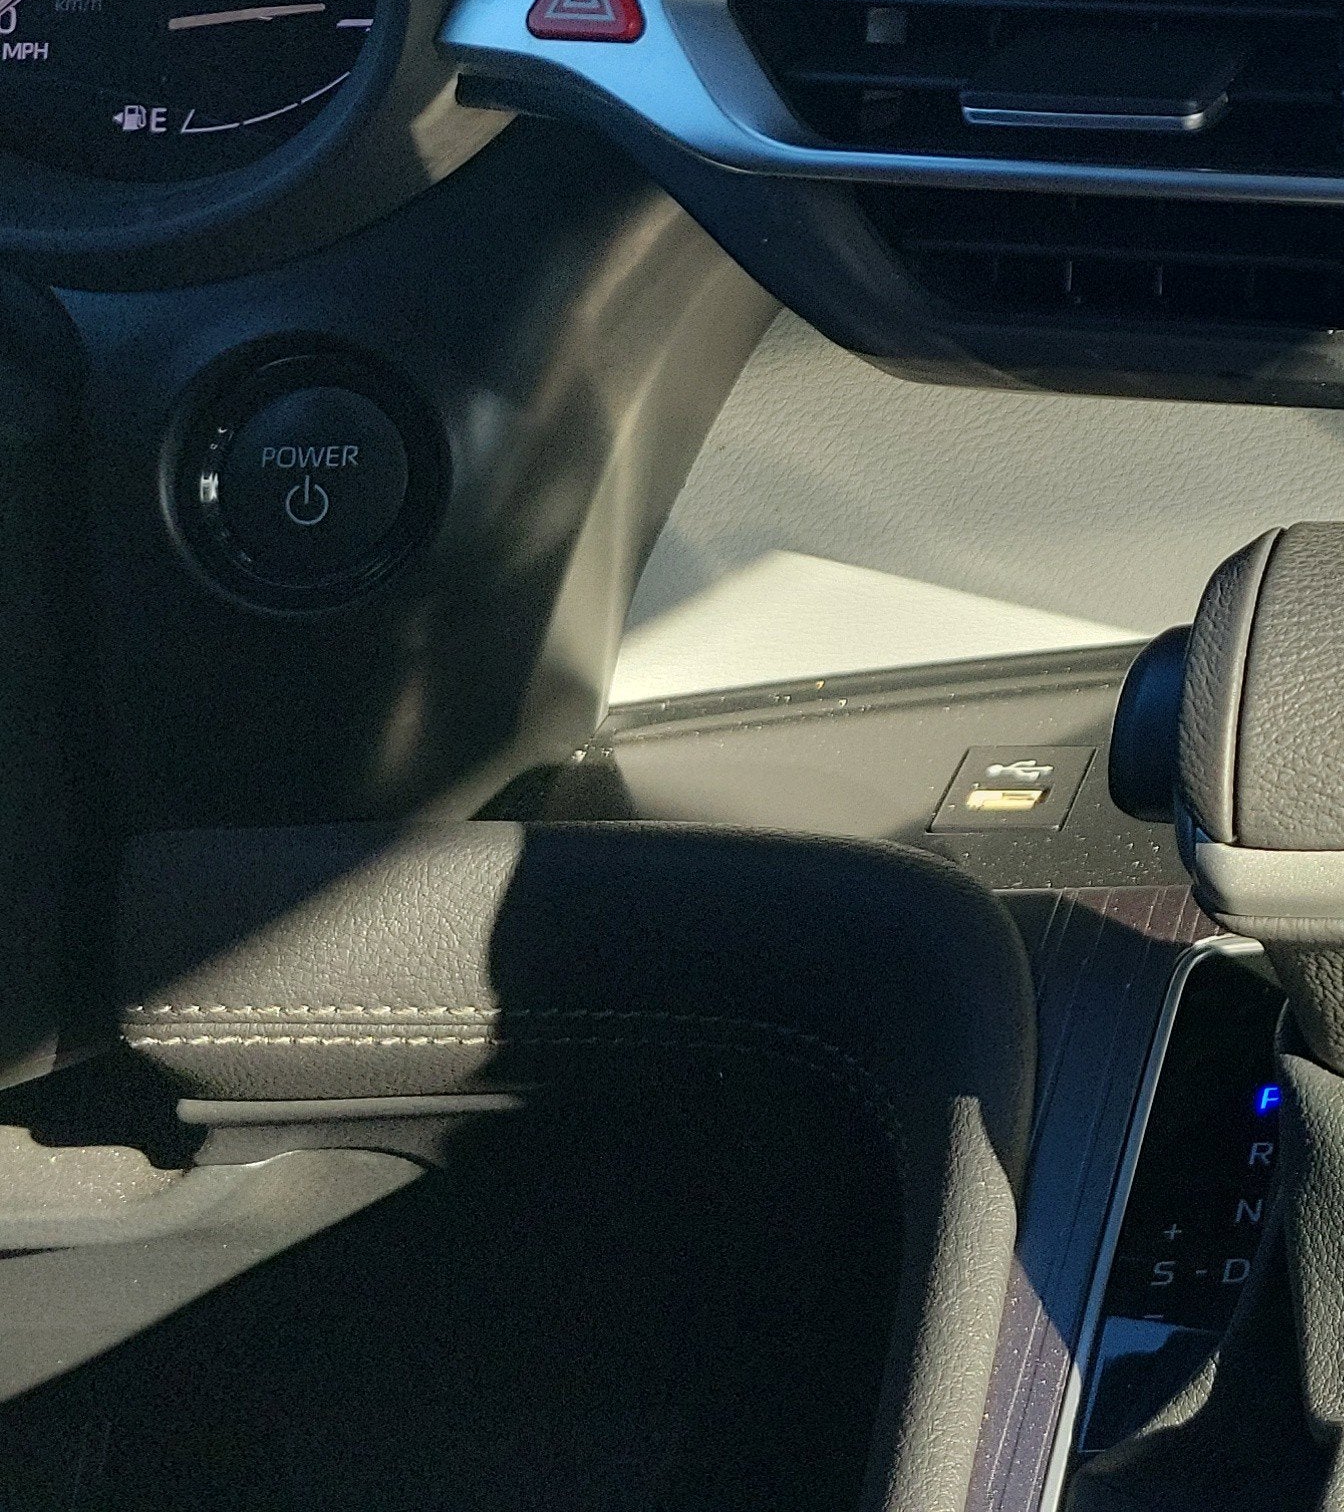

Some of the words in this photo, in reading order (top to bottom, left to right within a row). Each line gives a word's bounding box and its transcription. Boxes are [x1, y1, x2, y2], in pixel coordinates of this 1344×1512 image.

[2, 41, 50, 61] MPH
[150, 107, 169, 133] E
[261, 445, 360, 469] POWER
[1249, 1142, 1274, 1166] R
[1236, 1198, 1264, 1224] N
[1152, 1260, 1176, 1286] S
[1222, 1258, 1251, 1284] D
